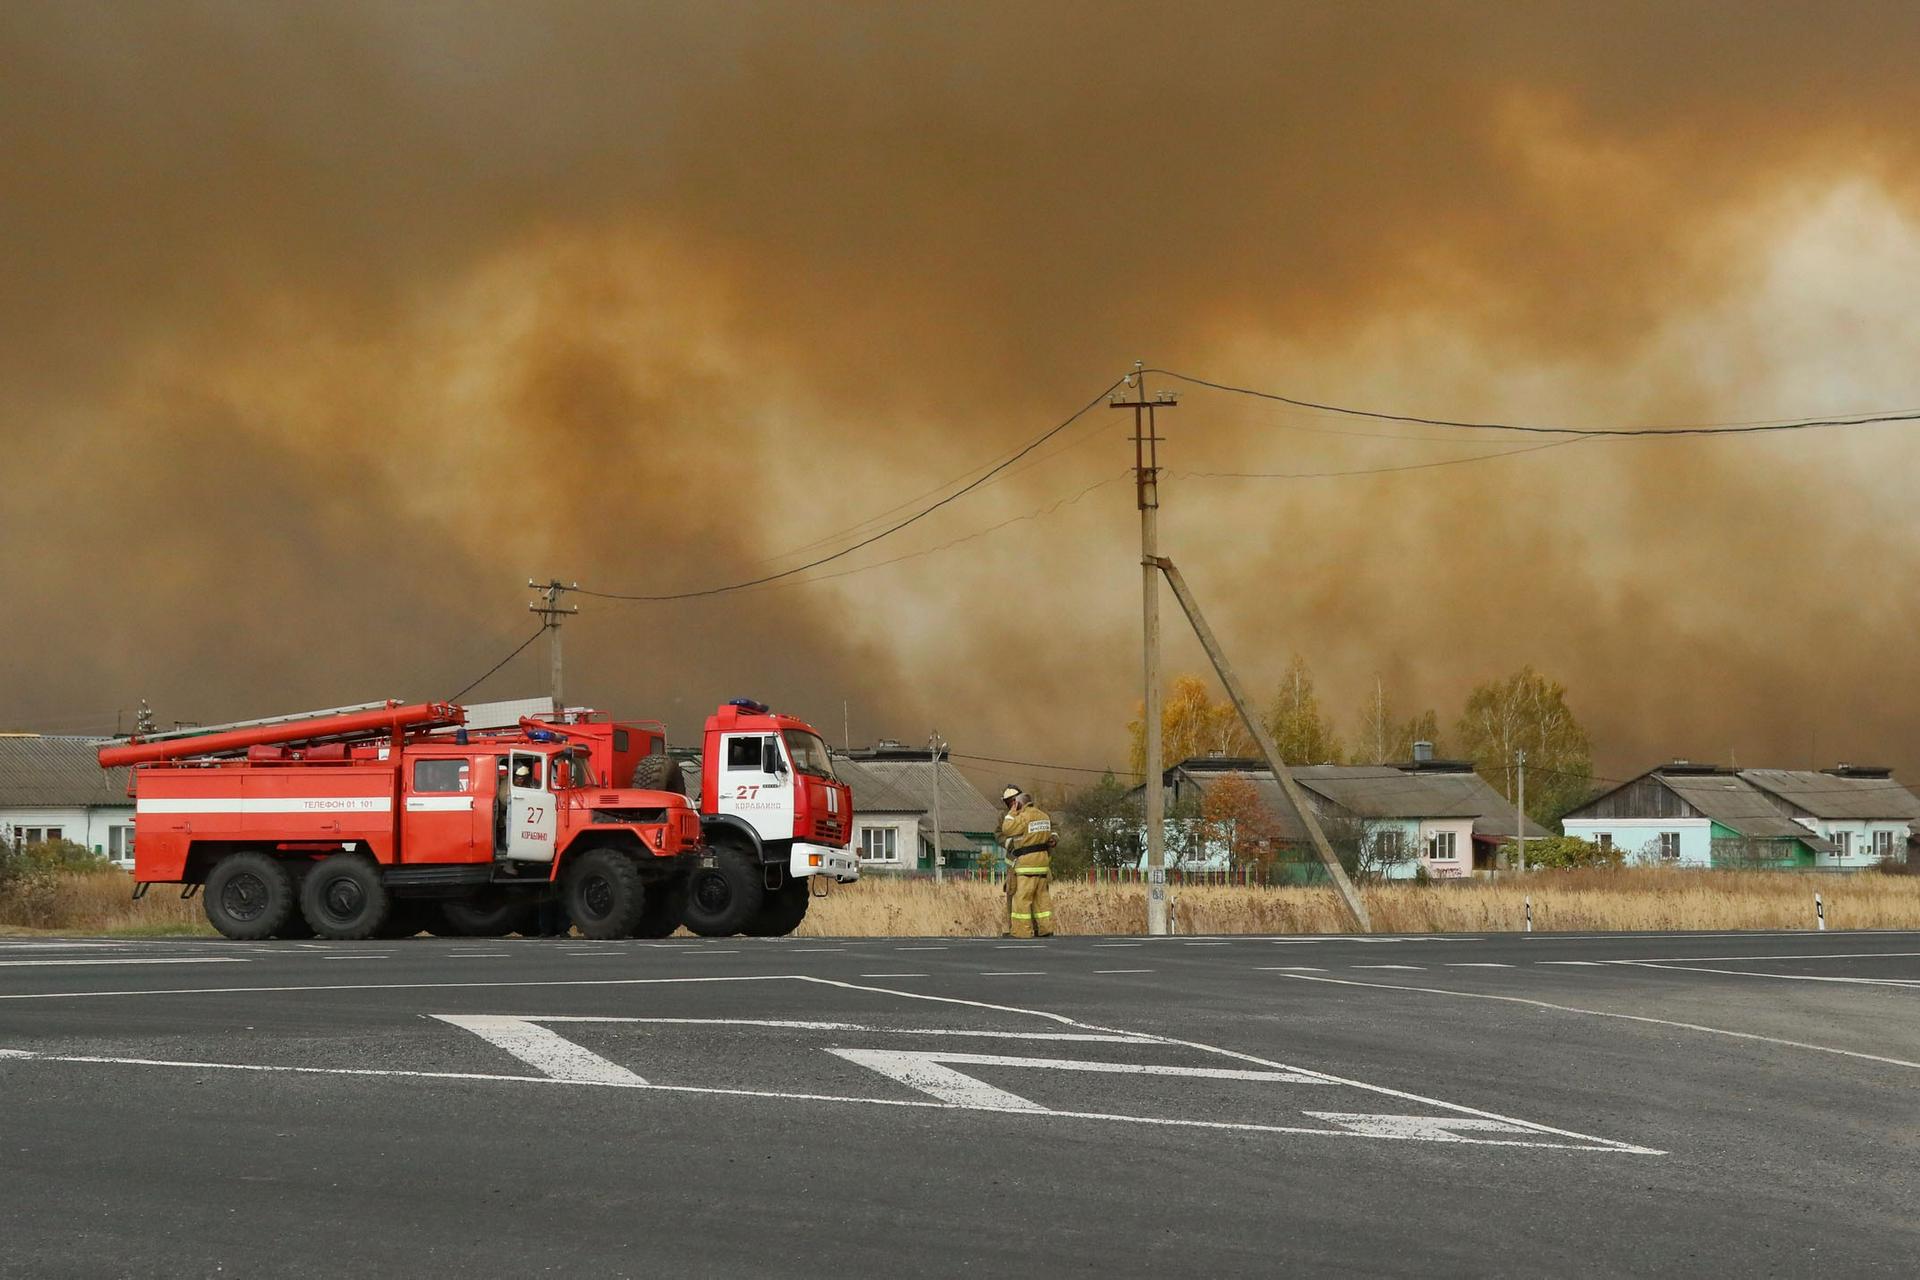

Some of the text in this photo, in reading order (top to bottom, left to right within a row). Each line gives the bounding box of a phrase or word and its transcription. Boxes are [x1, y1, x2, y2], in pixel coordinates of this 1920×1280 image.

[736, 785, 759, 799] 27
[346, 800, 355, 808] 01
[360, 800, 373, 808] 101
[527, 806, 543, 824] 27
